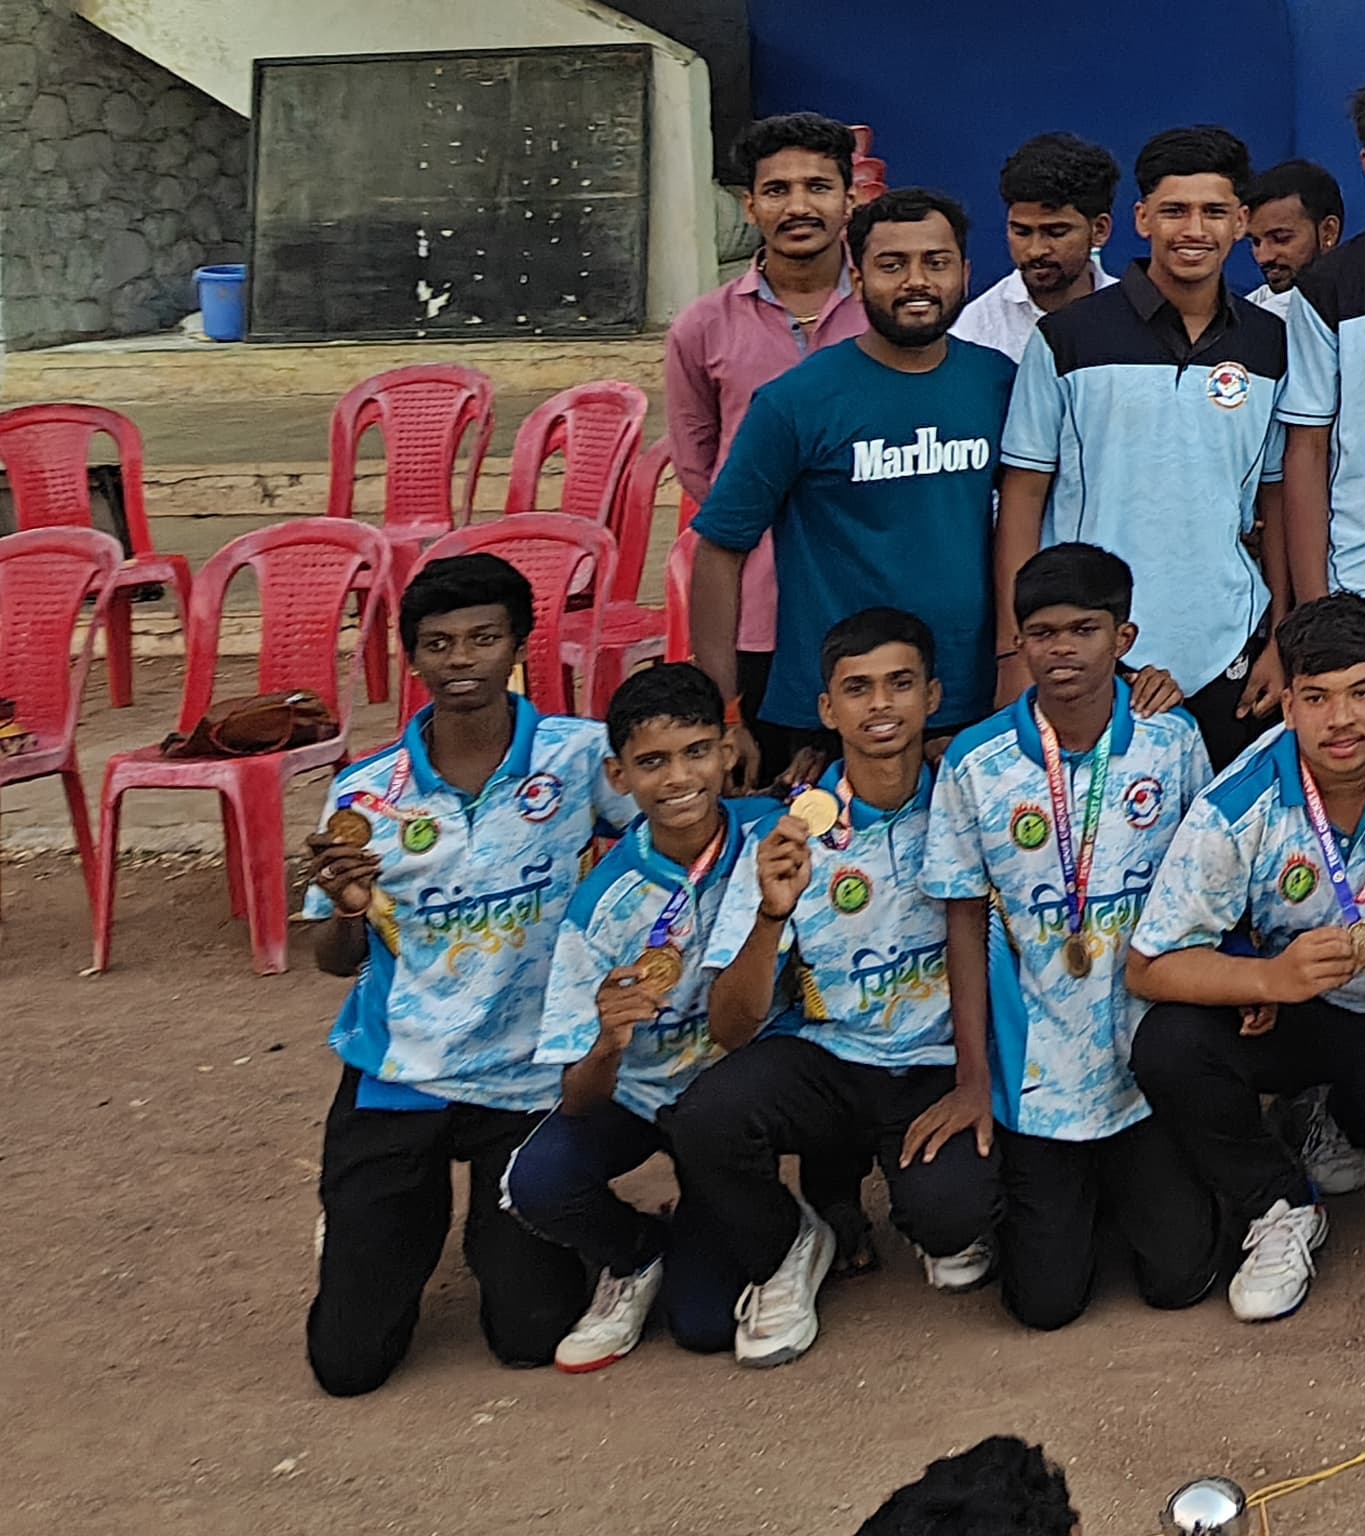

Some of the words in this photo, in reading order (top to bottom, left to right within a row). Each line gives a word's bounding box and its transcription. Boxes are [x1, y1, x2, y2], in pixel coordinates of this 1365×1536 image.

[851, 426, 990, 482] Marlboro
[1305, 791, 1329, 832] CRICKET
[1318, 829, 1341, 867] TENNIS
